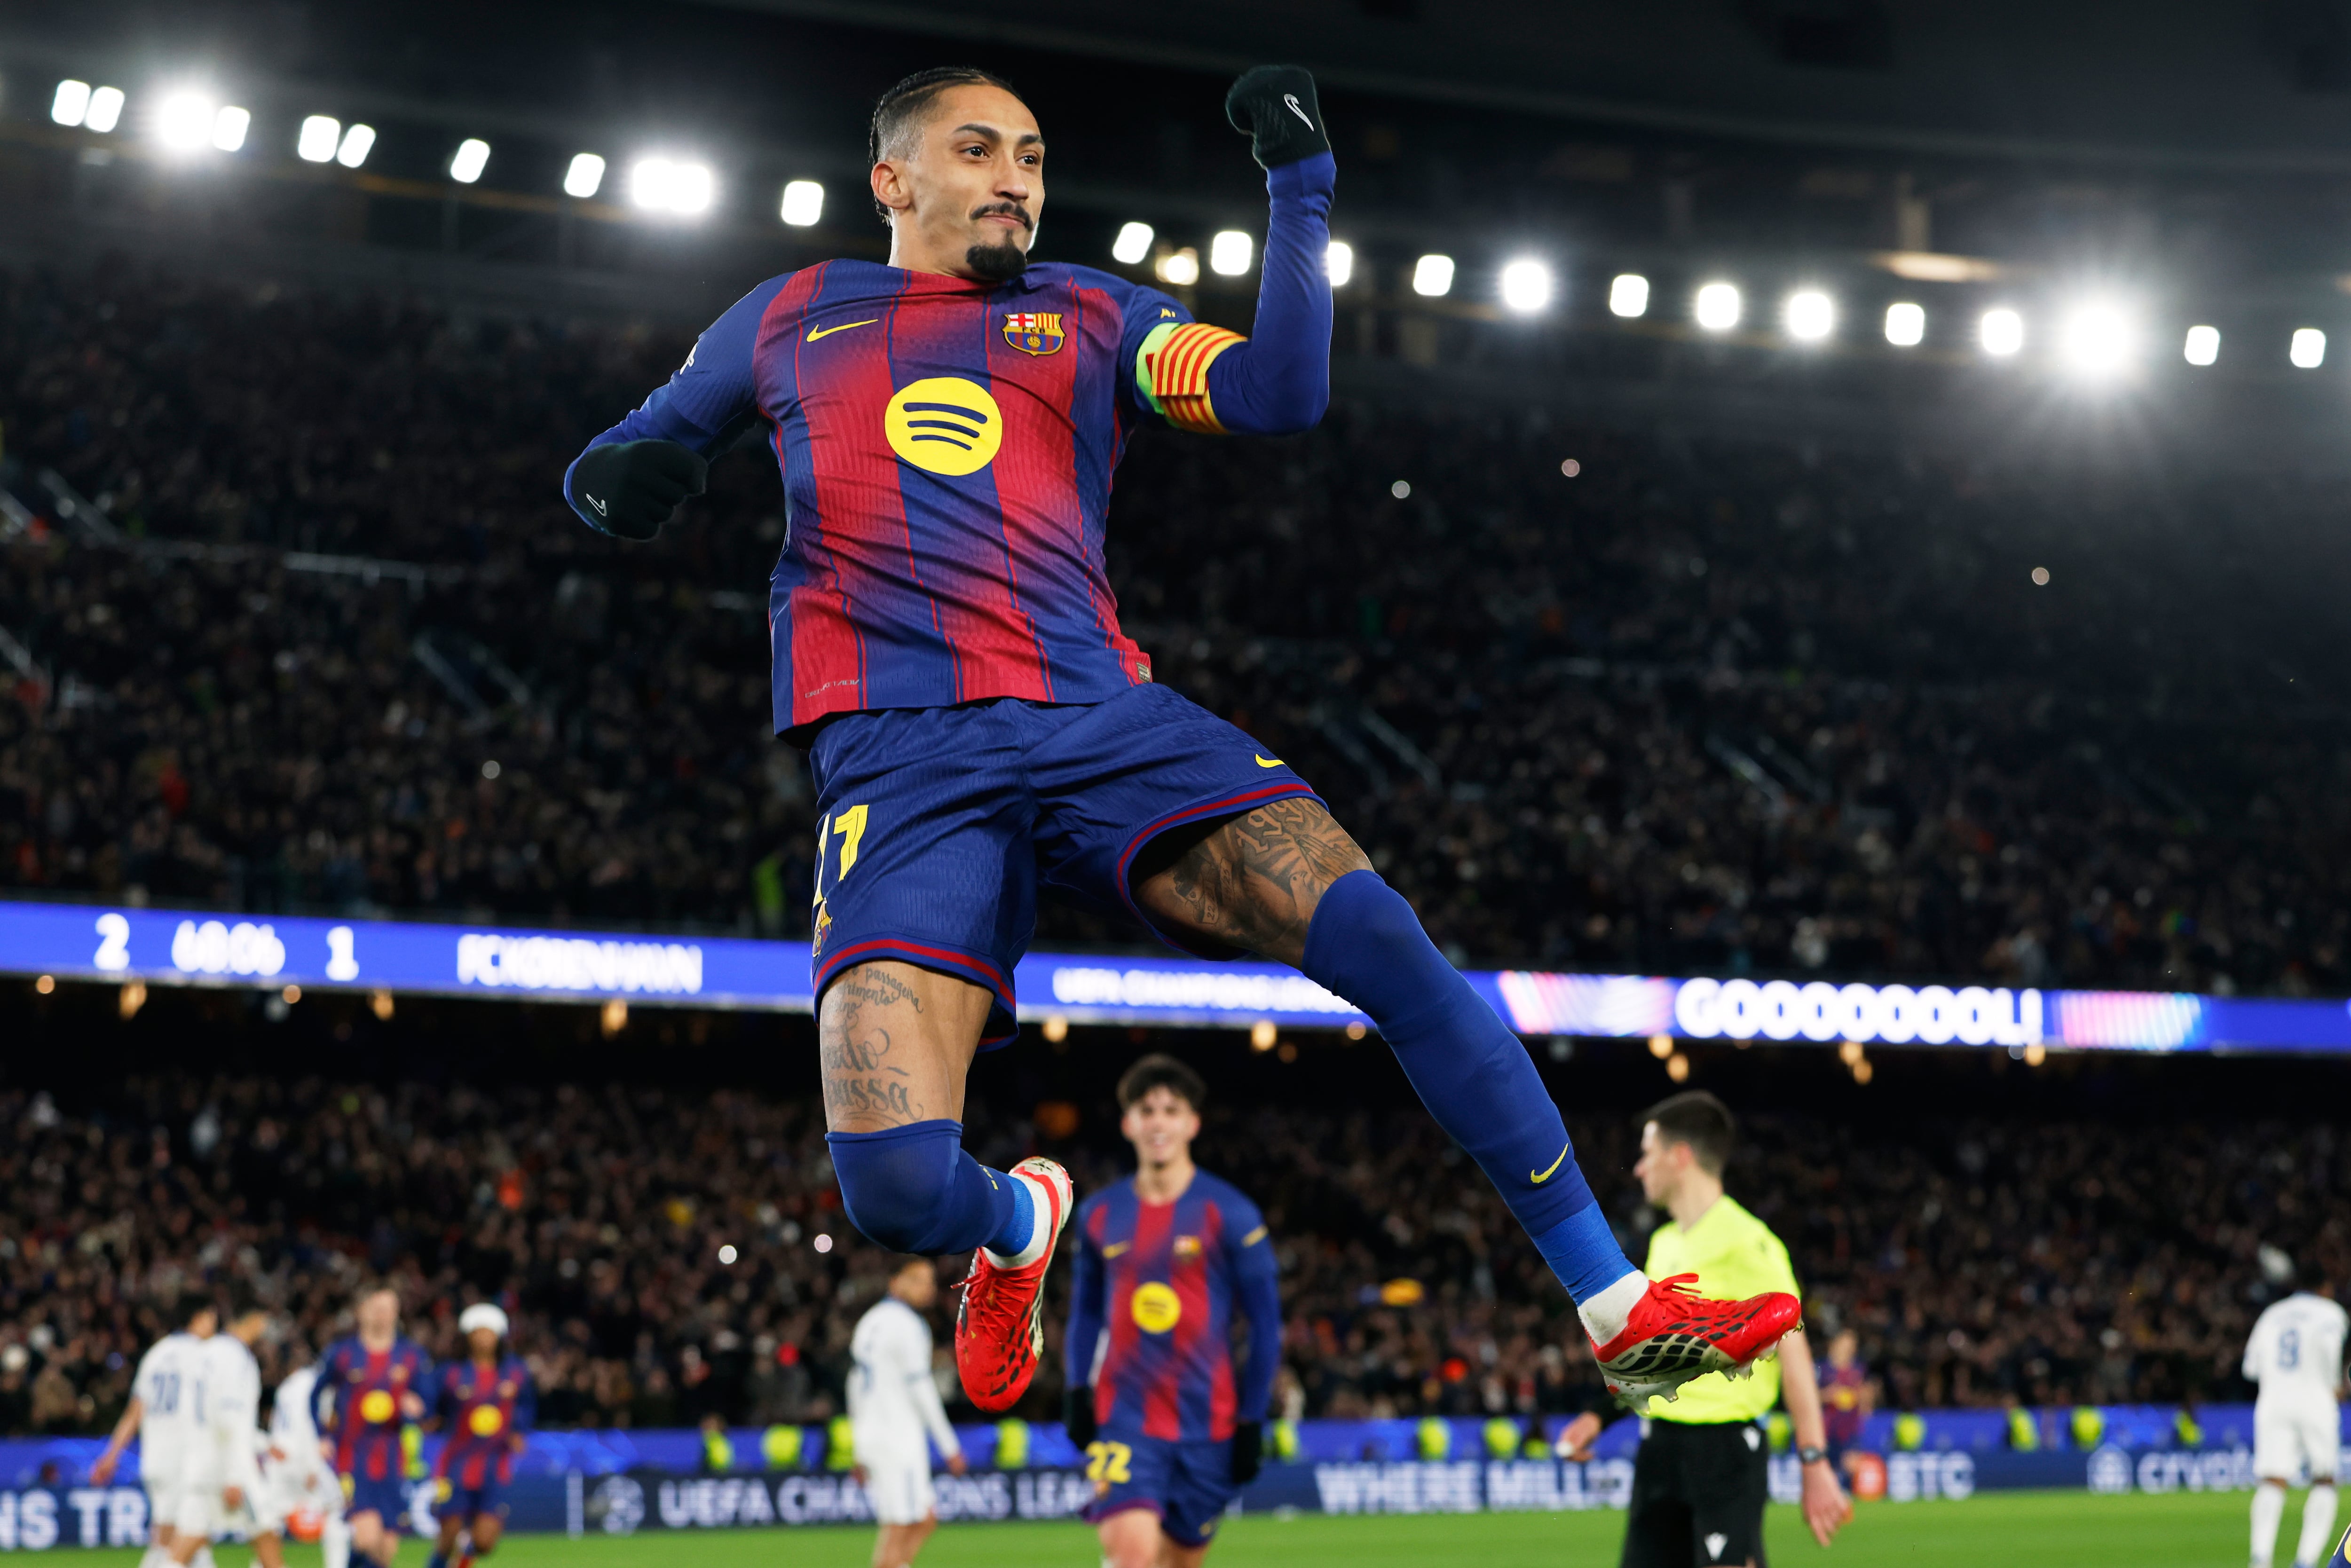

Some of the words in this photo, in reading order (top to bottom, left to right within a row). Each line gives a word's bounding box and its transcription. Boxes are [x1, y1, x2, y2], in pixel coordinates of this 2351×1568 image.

[94, 913, 130, 971] 2
[325, 925, 360, 981] 1
[1086, 1441, 1132, 1483] 22
[659, 1478, 775, 1528] UEFA
